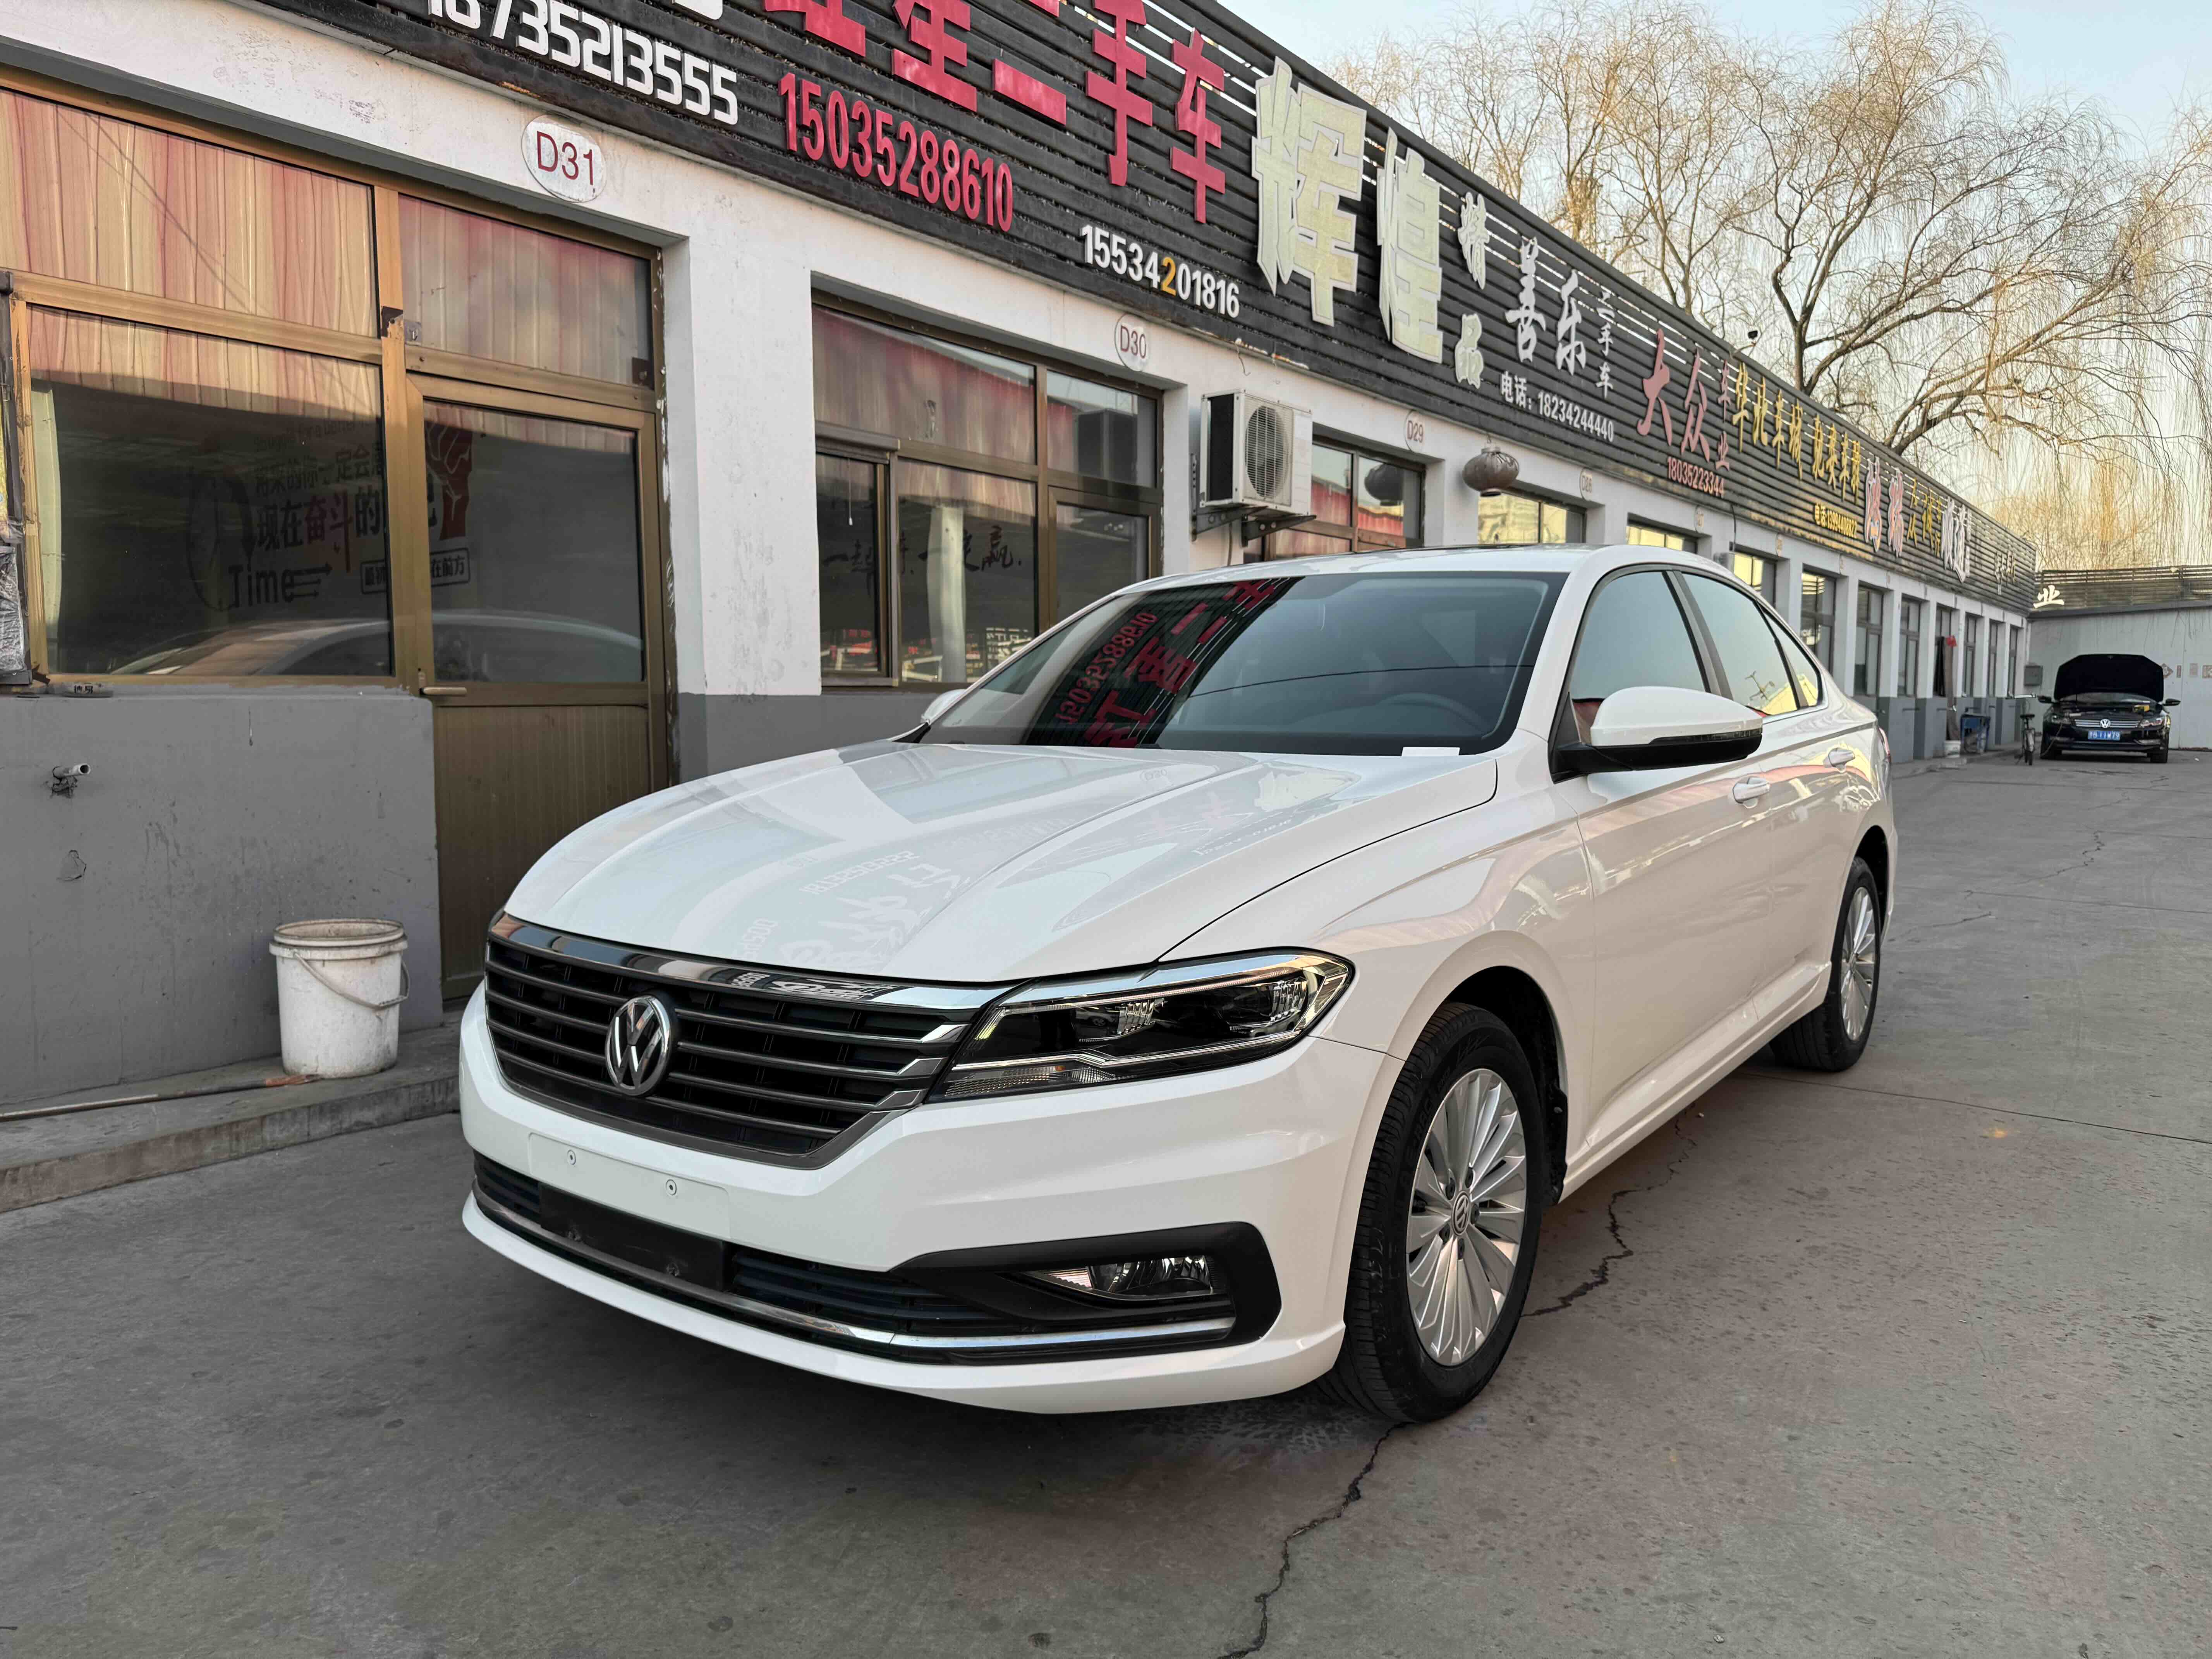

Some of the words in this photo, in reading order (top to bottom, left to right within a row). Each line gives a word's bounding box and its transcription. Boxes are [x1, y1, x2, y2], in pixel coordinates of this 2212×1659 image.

[537, 131, 594, 186] D31
[778, 72, 1013, 232] 15035288610
[1080, 225, 1239, 318] 15534201816
[1120, 322, 1147, 359] D30
[1596, 291, 1615, 398] 二手车
[1538, 392, 1614, 443] 18234244440
[1637, 328, 1710, 463] 大众
[1407, 418, 1424, 443] D29
[1667, 456, 1725, 498] 18035223344
[228, 563, 294, 608] Time
[2033, 585, 2064, 608] 业
